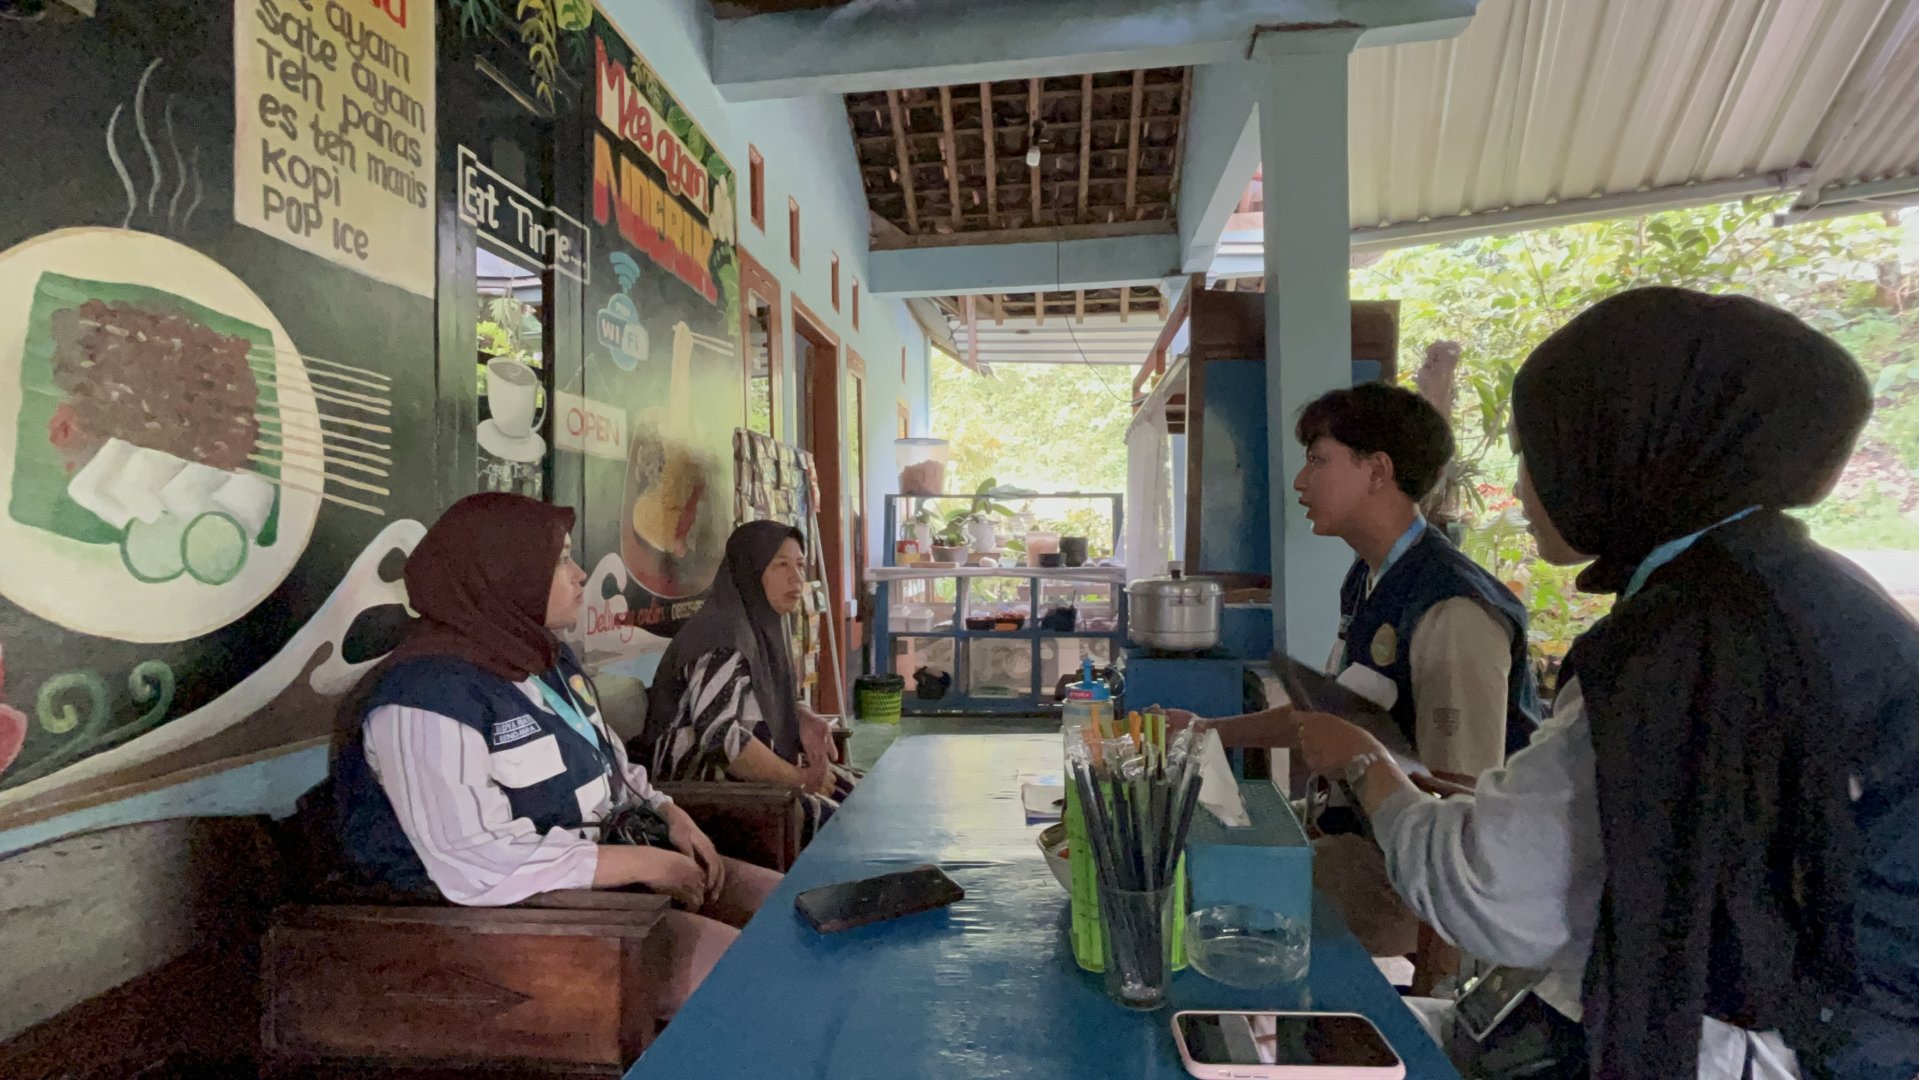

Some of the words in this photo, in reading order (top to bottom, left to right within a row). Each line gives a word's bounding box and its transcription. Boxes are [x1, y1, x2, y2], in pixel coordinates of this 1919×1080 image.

[325, 0, 410, 84] ayam
[342, 93, 422, 168] panas
[351, 60, 426, 134] ayam
[258, 93, 297, 141] es
[367, 152, 427, 209] manis
[566, 407, 621, 447] OPEN
